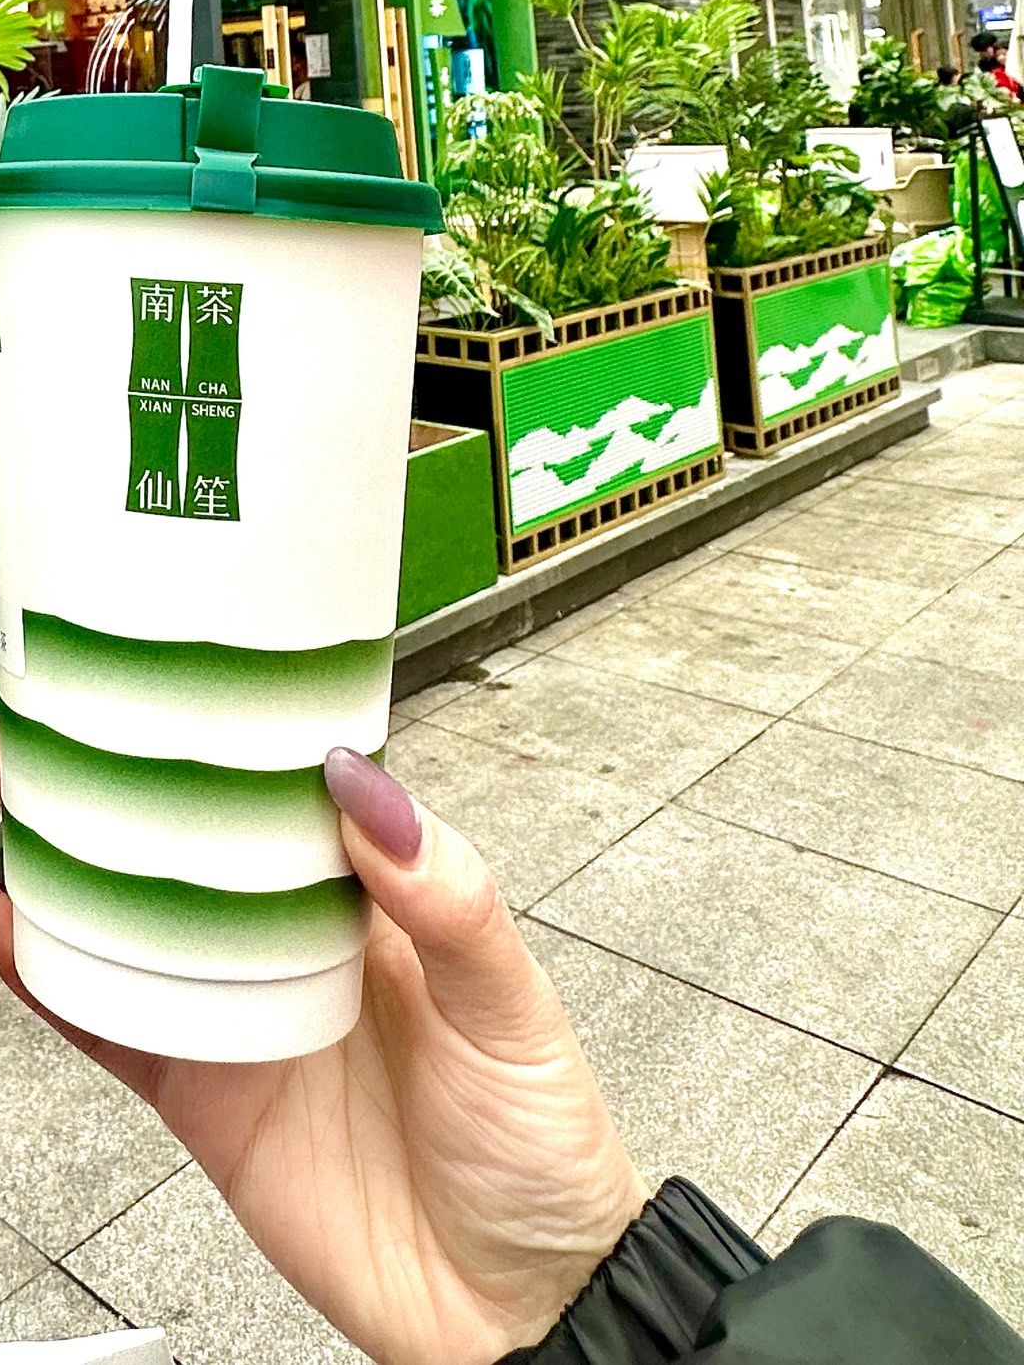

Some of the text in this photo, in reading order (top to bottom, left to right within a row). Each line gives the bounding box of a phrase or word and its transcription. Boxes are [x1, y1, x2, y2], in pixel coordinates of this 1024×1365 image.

[140, 283, 233, 325] 南茶
[141, 378, 228, 396] NAN CHA
[139, 399, 235, 418] XIAN SHENG
[136, 469, 230, 518] 仙笙
